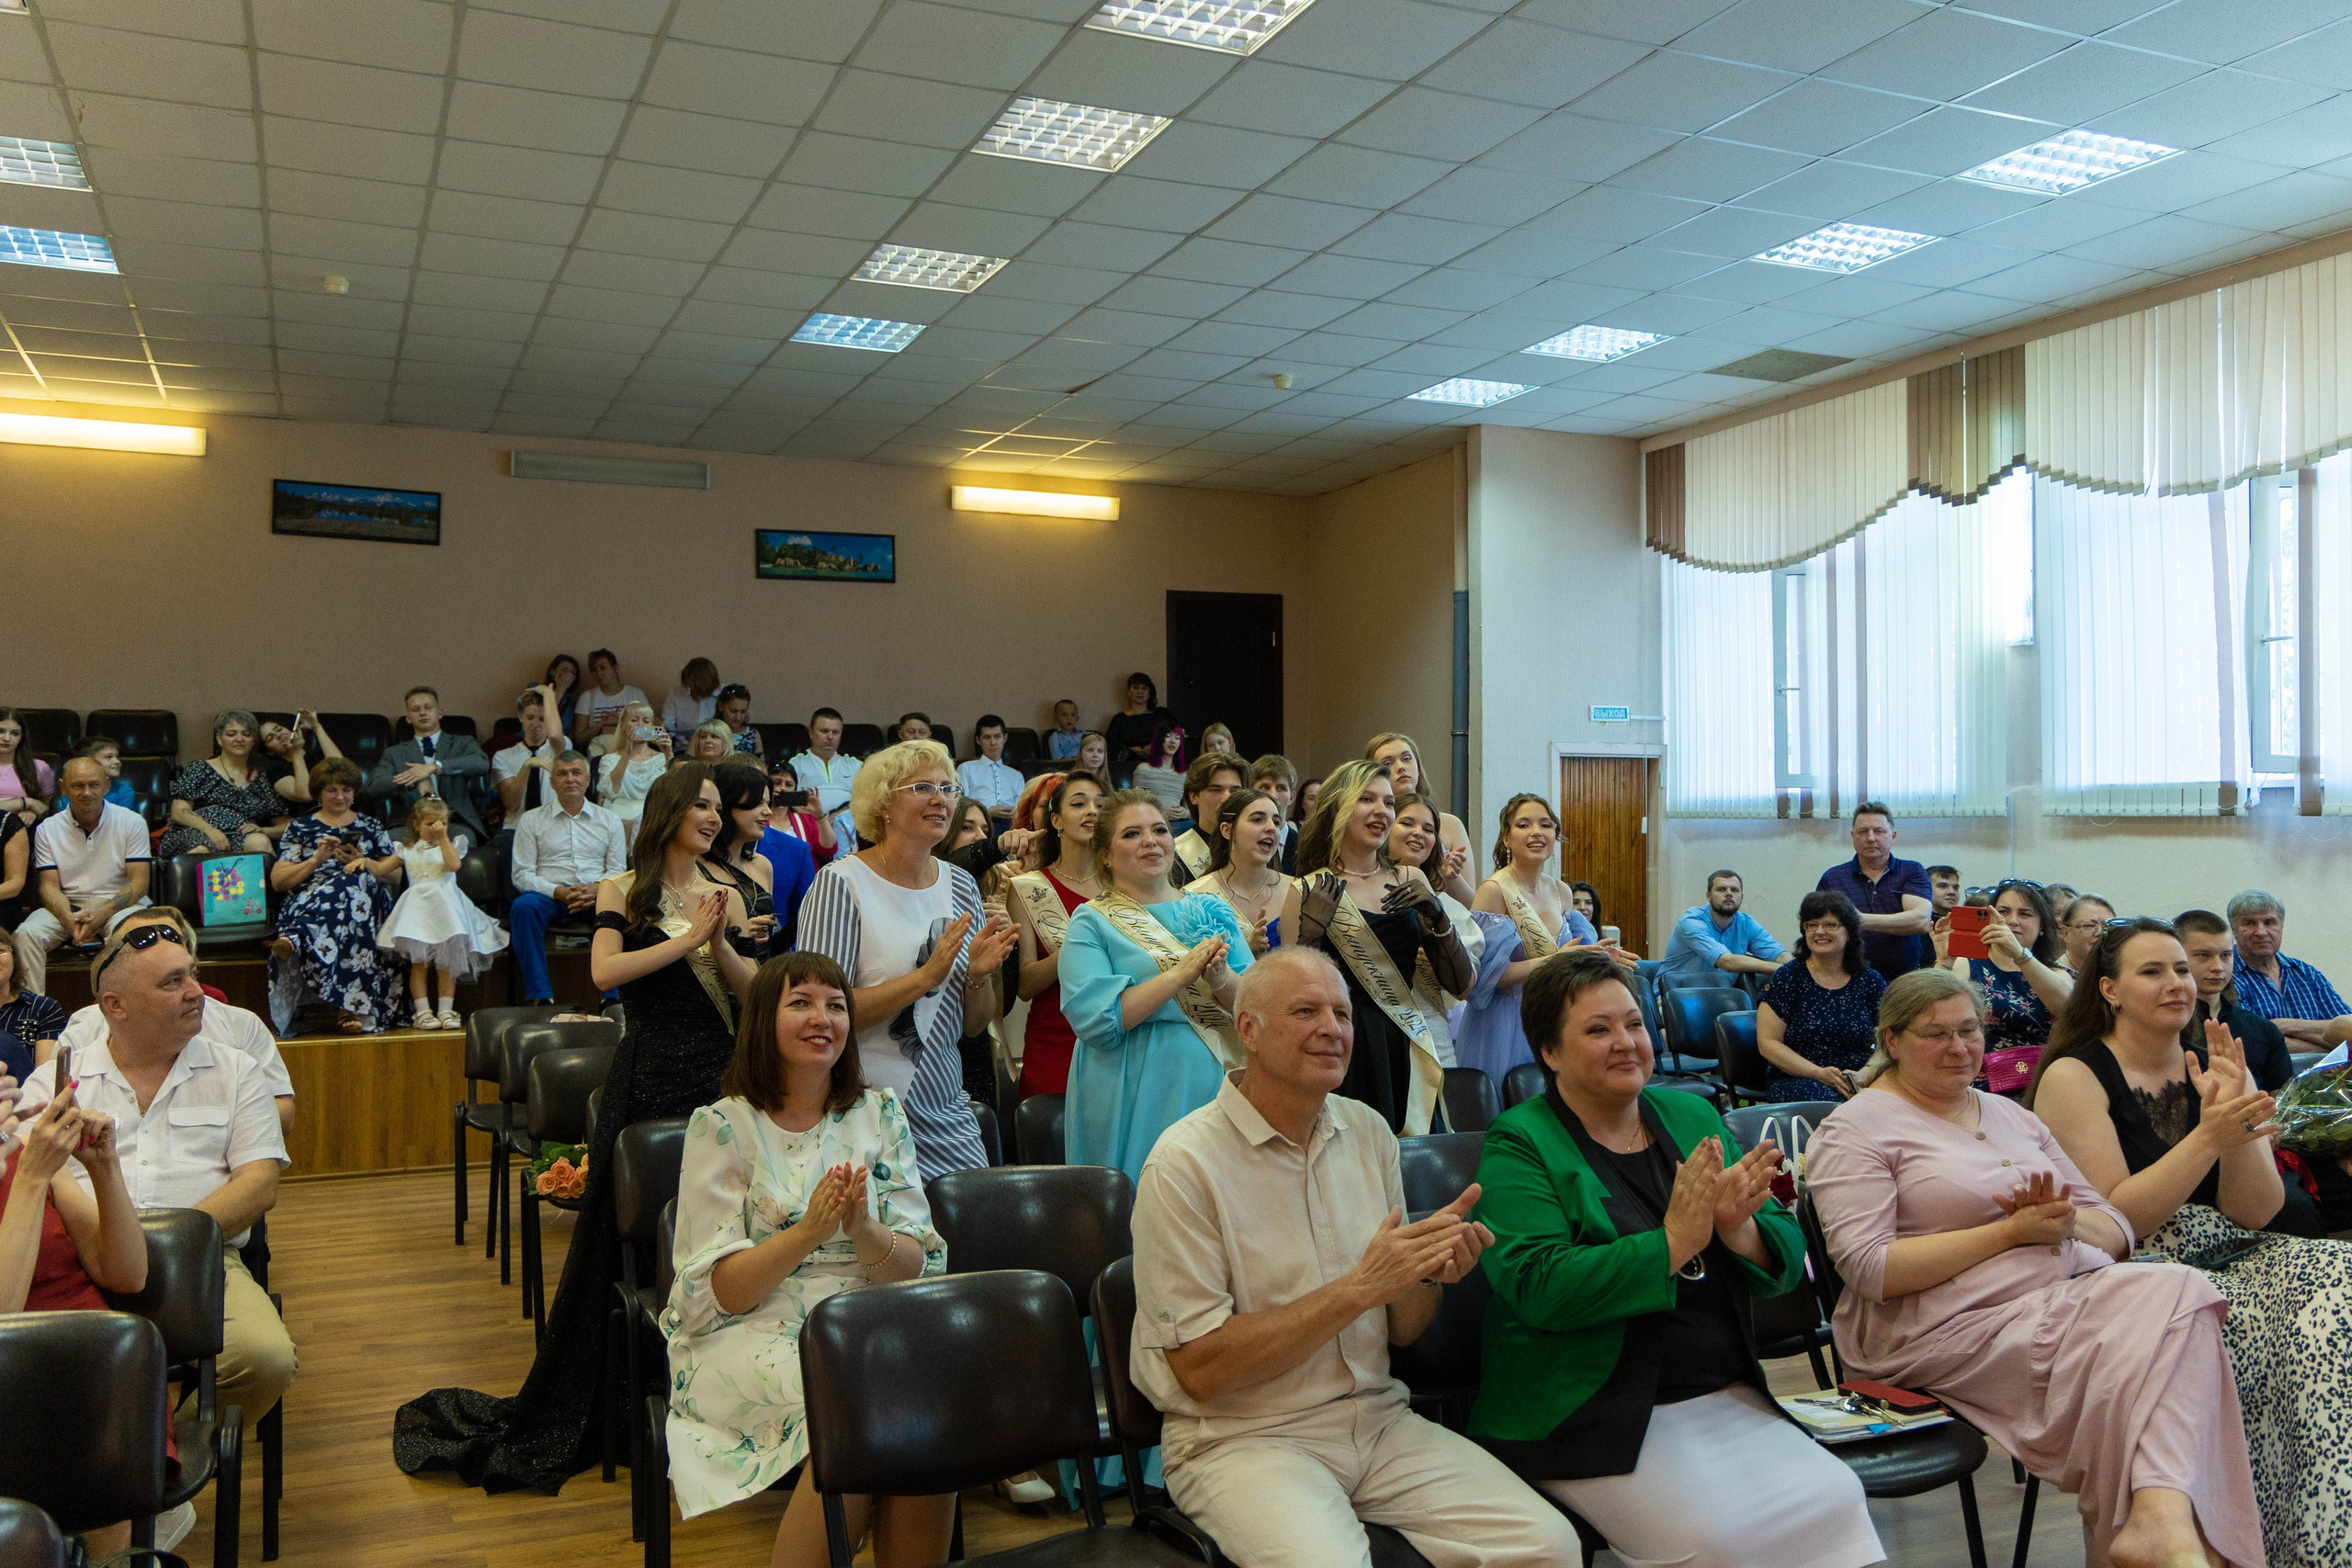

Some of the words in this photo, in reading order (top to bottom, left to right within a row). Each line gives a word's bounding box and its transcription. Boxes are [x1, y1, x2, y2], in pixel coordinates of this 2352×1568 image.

[1594, 708, 1626, 718] ВЫХОД
[1191, 1001, 1228, 1030] 2024
[1397, 1008, 1428, 1036] 2024
